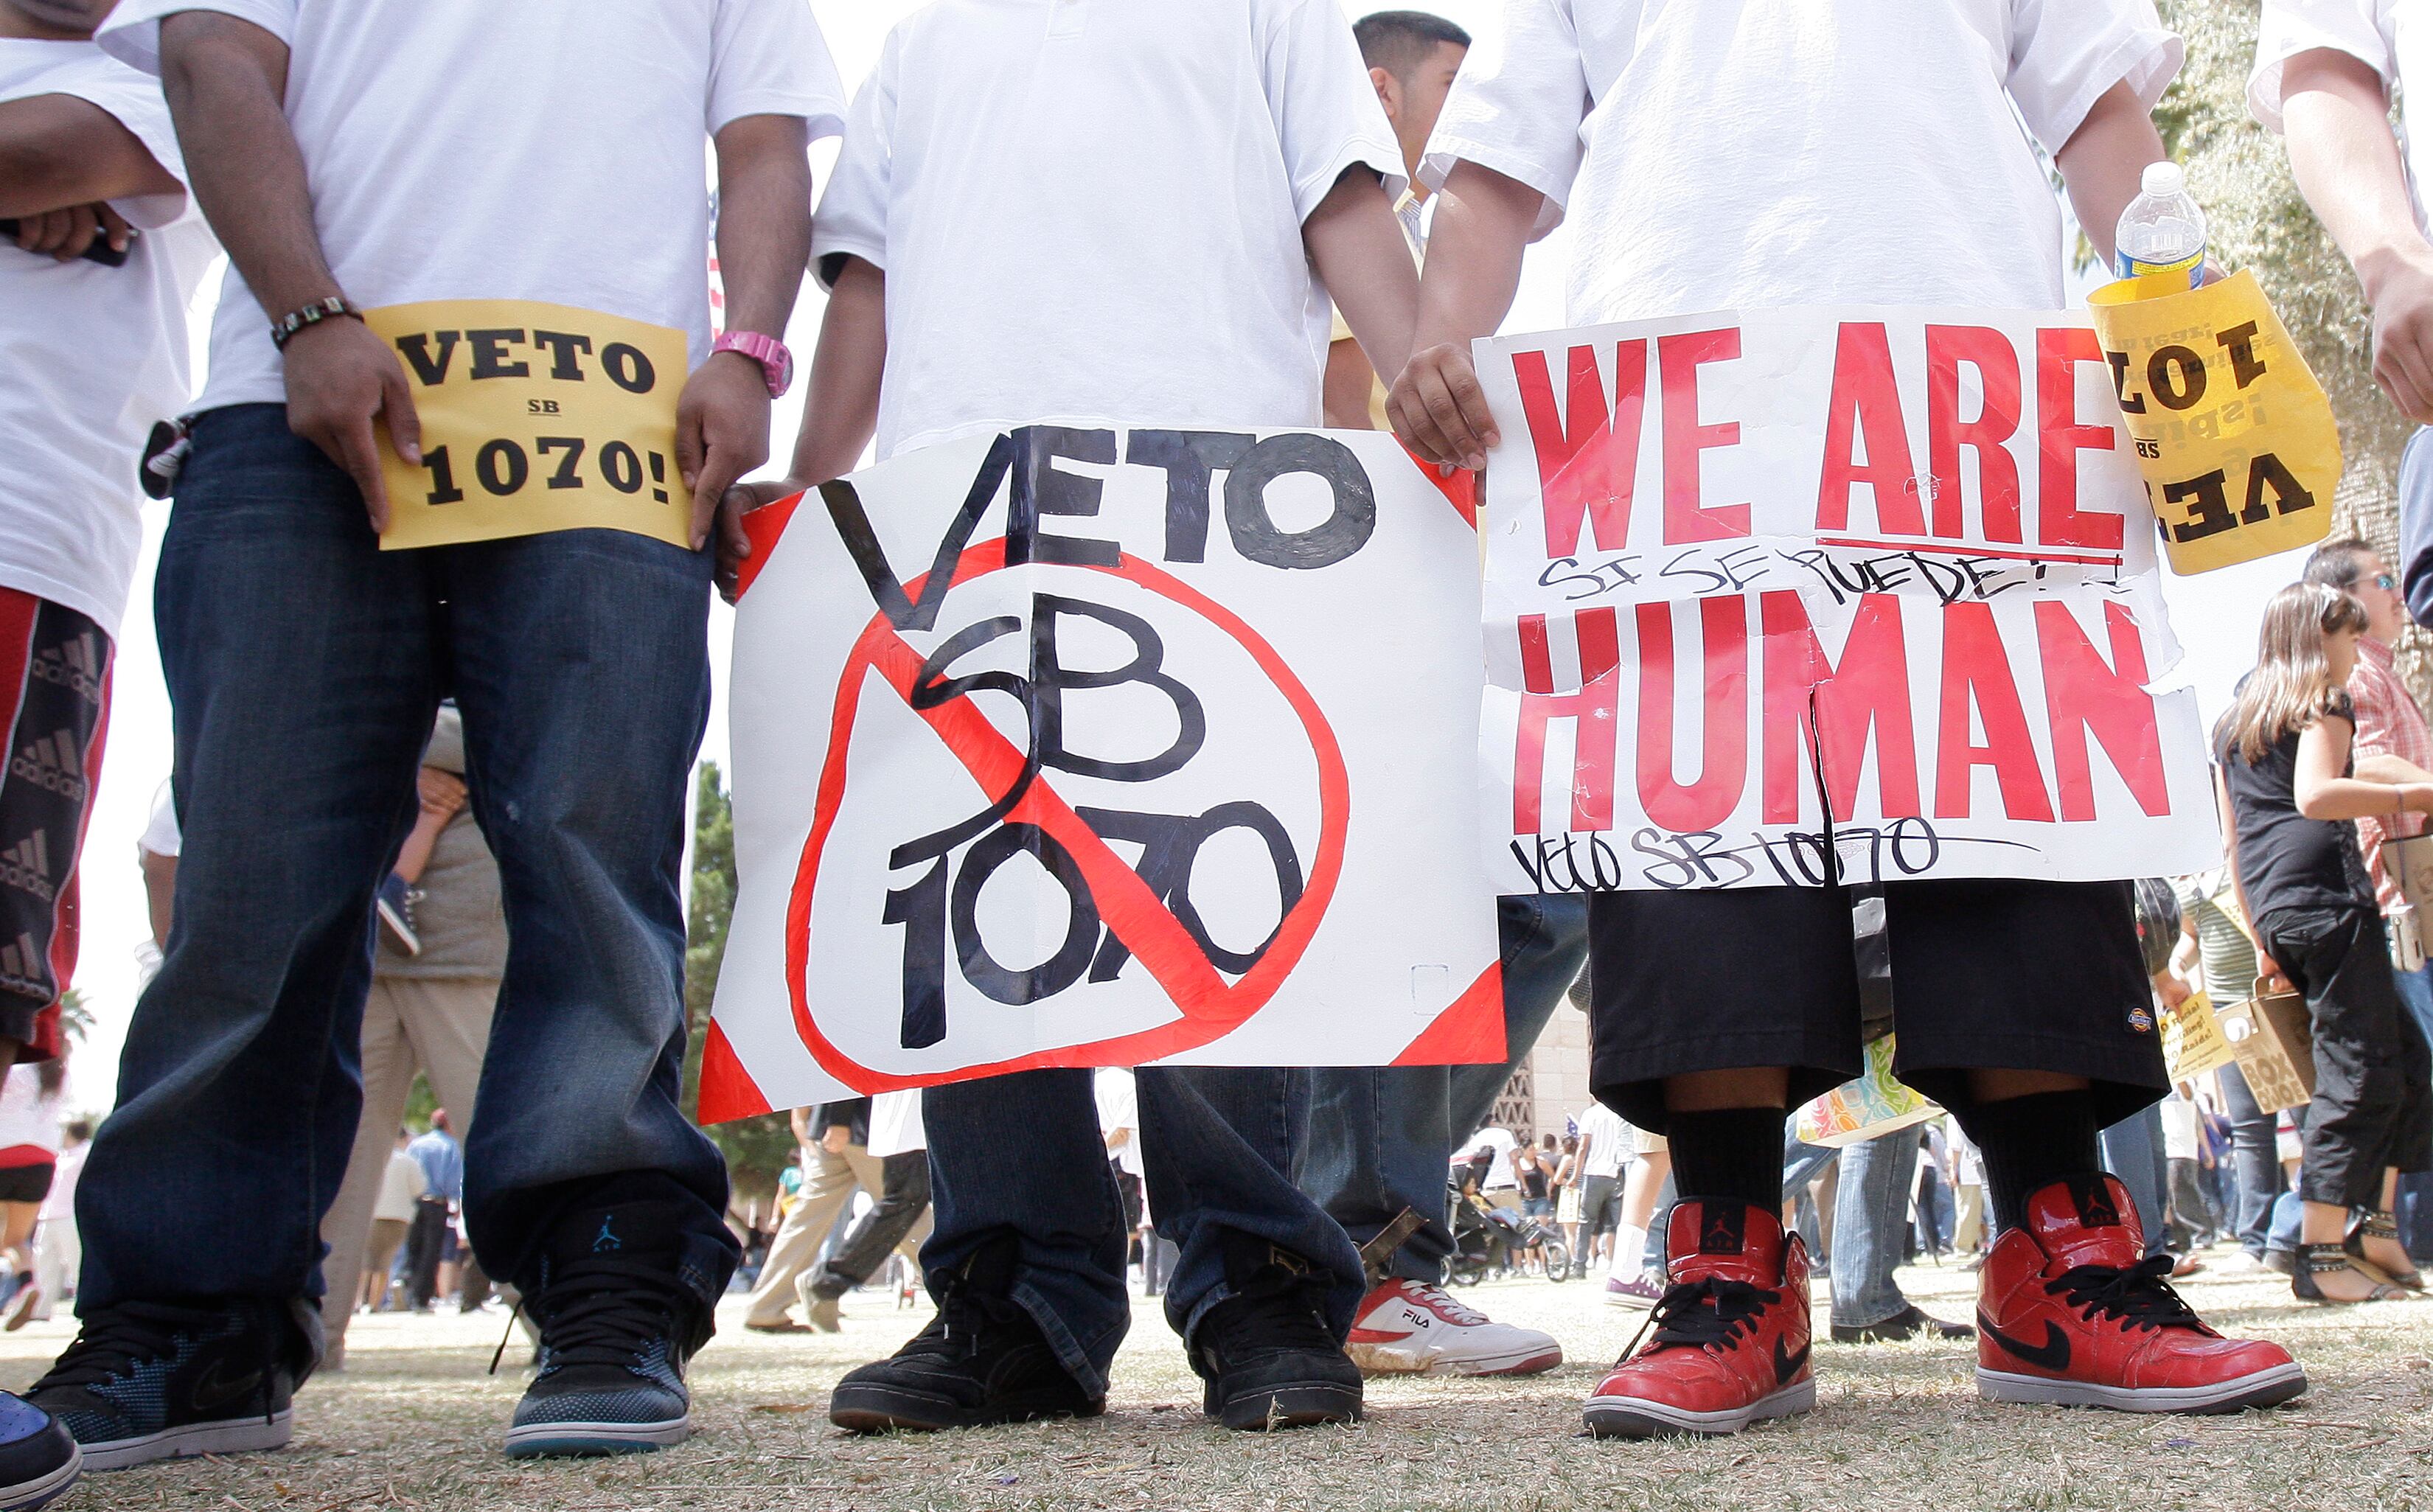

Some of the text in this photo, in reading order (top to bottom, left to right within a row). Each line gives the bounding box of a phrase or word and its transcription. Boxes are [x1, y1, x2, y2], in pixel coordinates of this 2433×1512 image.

[396, 328, 655, 394] VETO
[527, 399, 561, 414] SB
[1511, 321, 2124, 560] WE ARE
[422, 436, 669, 506] 1070!
[818, 425, 1376, 631] VETO
[1538, 554, 1643, 601] SI
[1659, 546, 1770, 594] SE
[889, 592, 1206, 871] SB
[1514, 589, 2171, 835] HUMAN
[1631, 827, 1755, 890] SB
[883, 801, 1303, 1049] 1070
[1402, 1309, 1430, 1328] FILA
